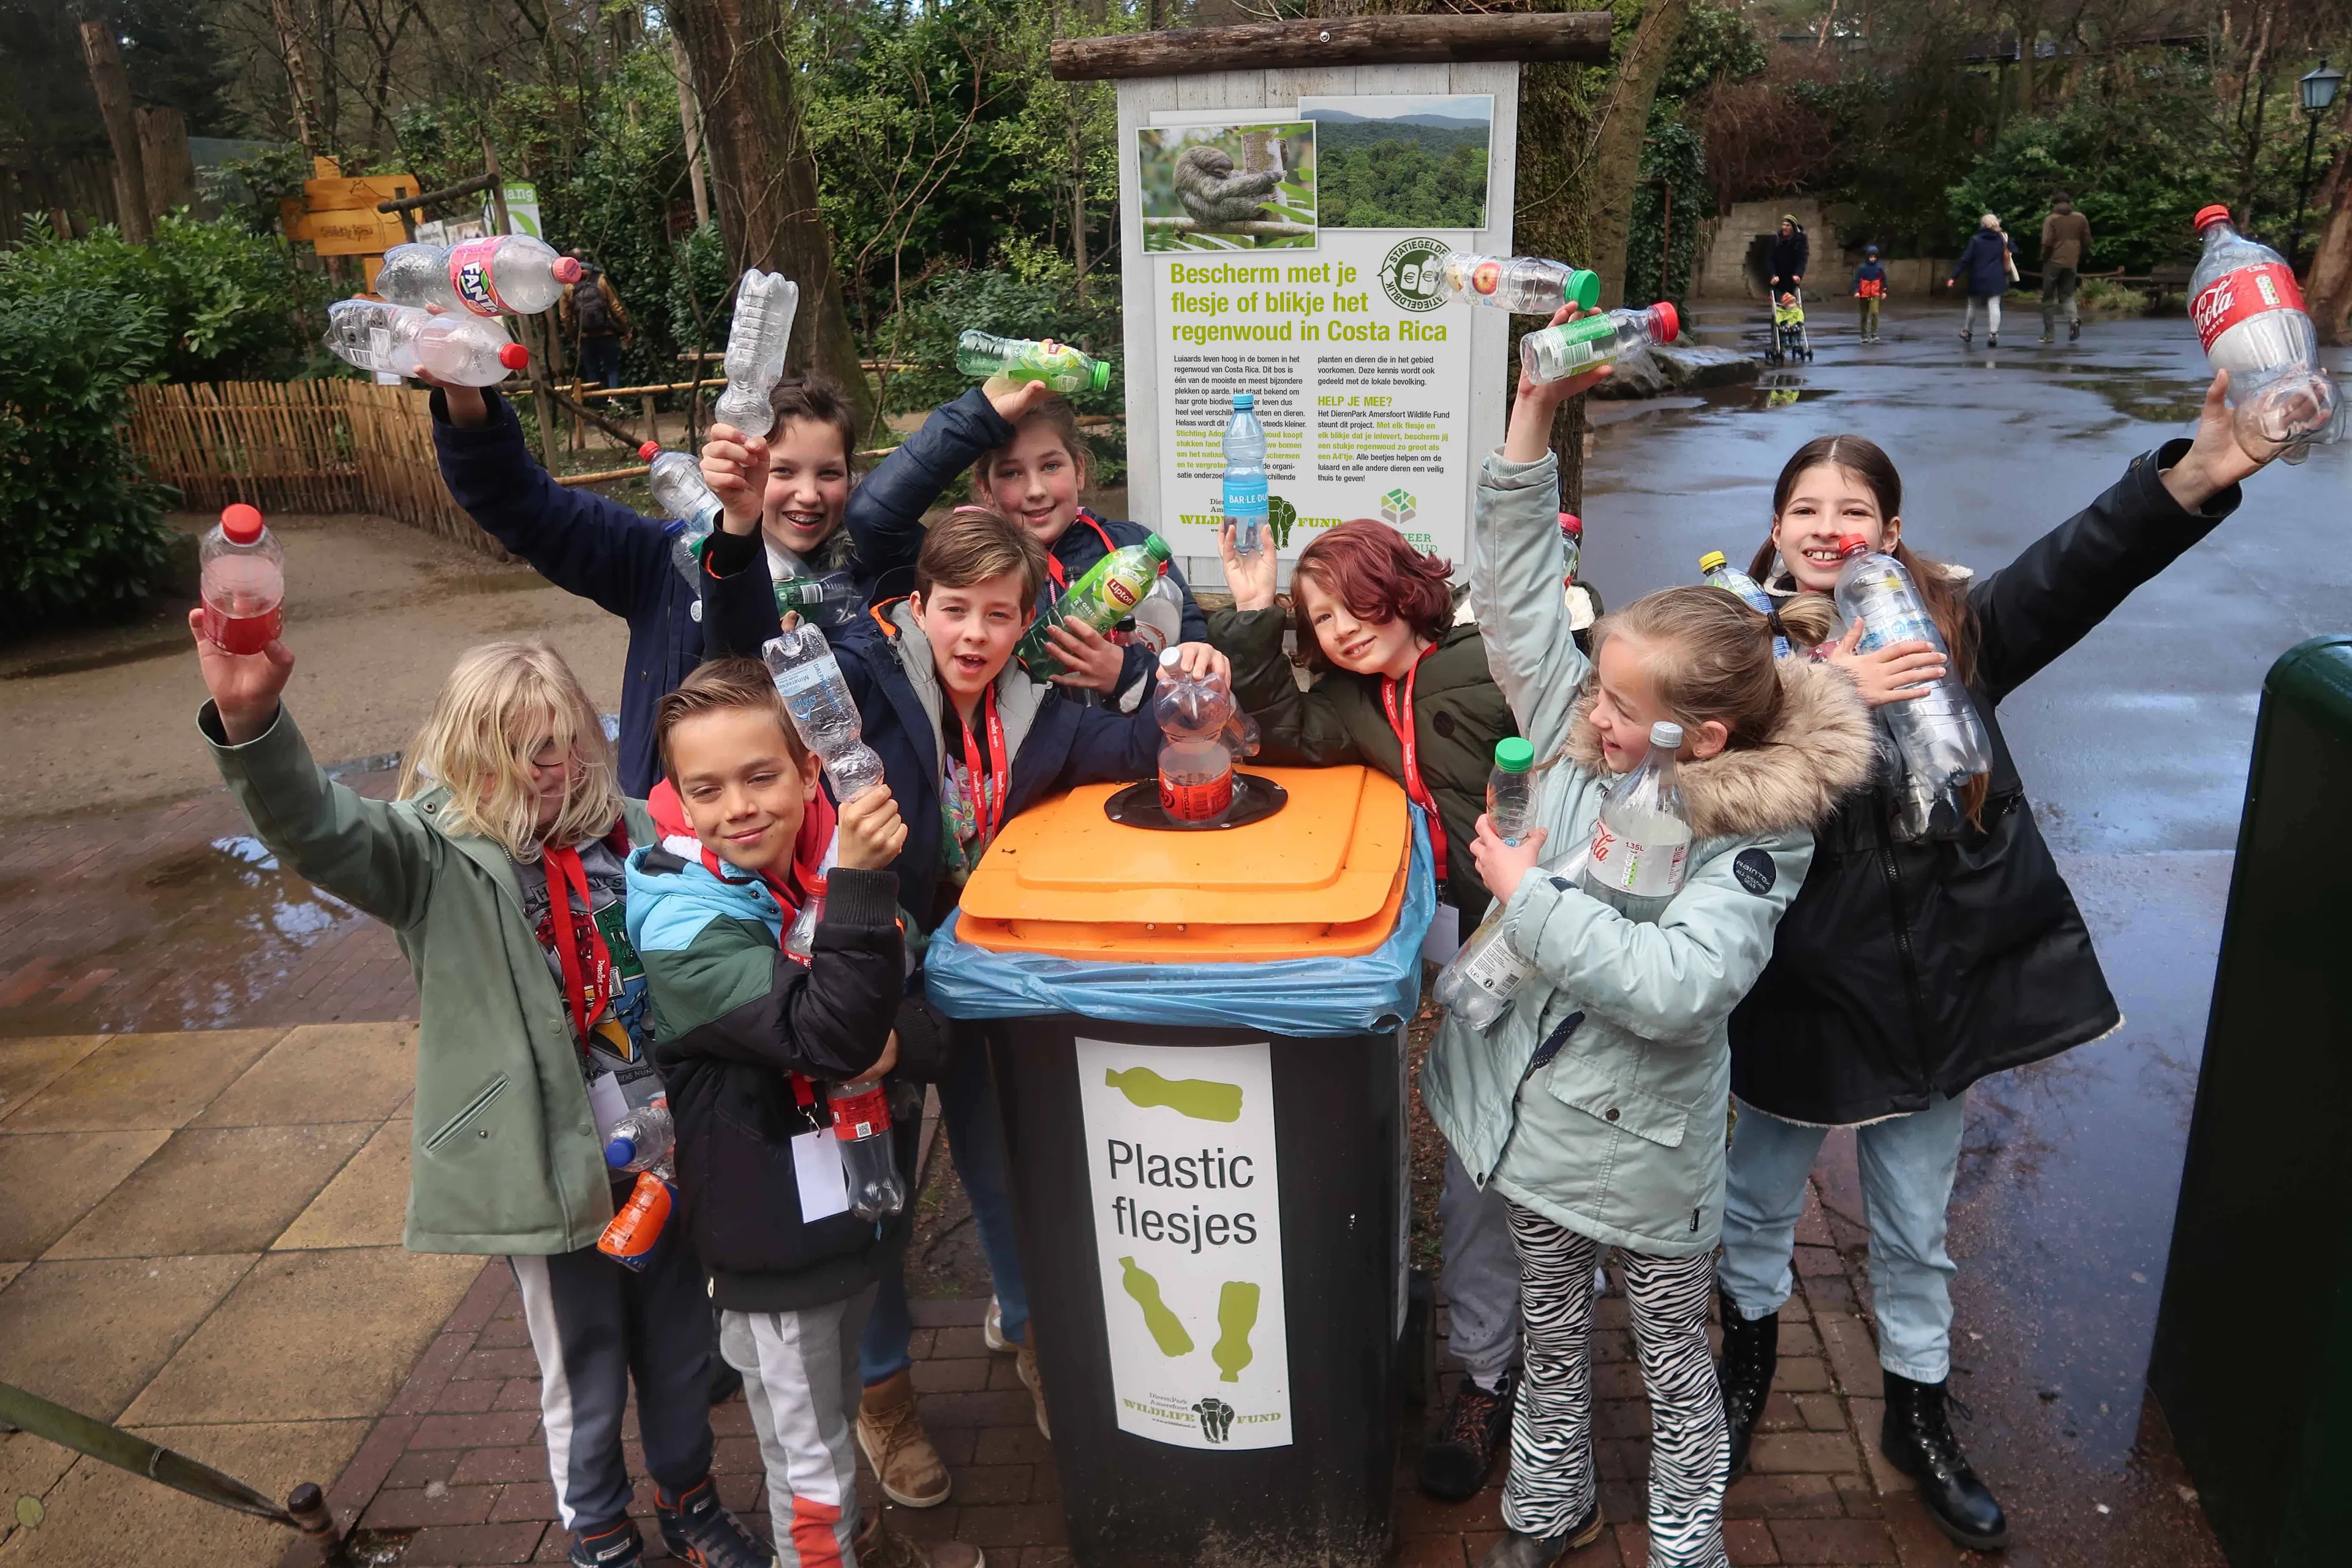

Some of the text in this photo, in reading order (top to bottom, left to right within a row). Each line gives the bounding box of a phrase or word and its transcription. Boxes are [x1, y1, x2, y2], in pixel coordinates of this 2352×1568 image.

[1171, 262, 1357, 287] Bescherm met je
[463, 262, 499, 313] FANTA
[1171, 292, 1368, 317] flesje of blikje het
[1172, 320, 1446, 345] regenwoud in Costa Rica
[2206, 317, 2225, 336] TASTE
[1318, 396, 1392, 406] HELP JE MEE?
[1110, 581, 1133, 605] Lipton
[1082, 602, 1098, 620] GREEN
[1625, 842, 1645, 852] 1.35L
[1108, 1139, 1254, 1189] Plastic
[1112, 1195, 1257, 1254] flesjes
[1123, 1398, 1281, 1424] WILDLIFE FUND
